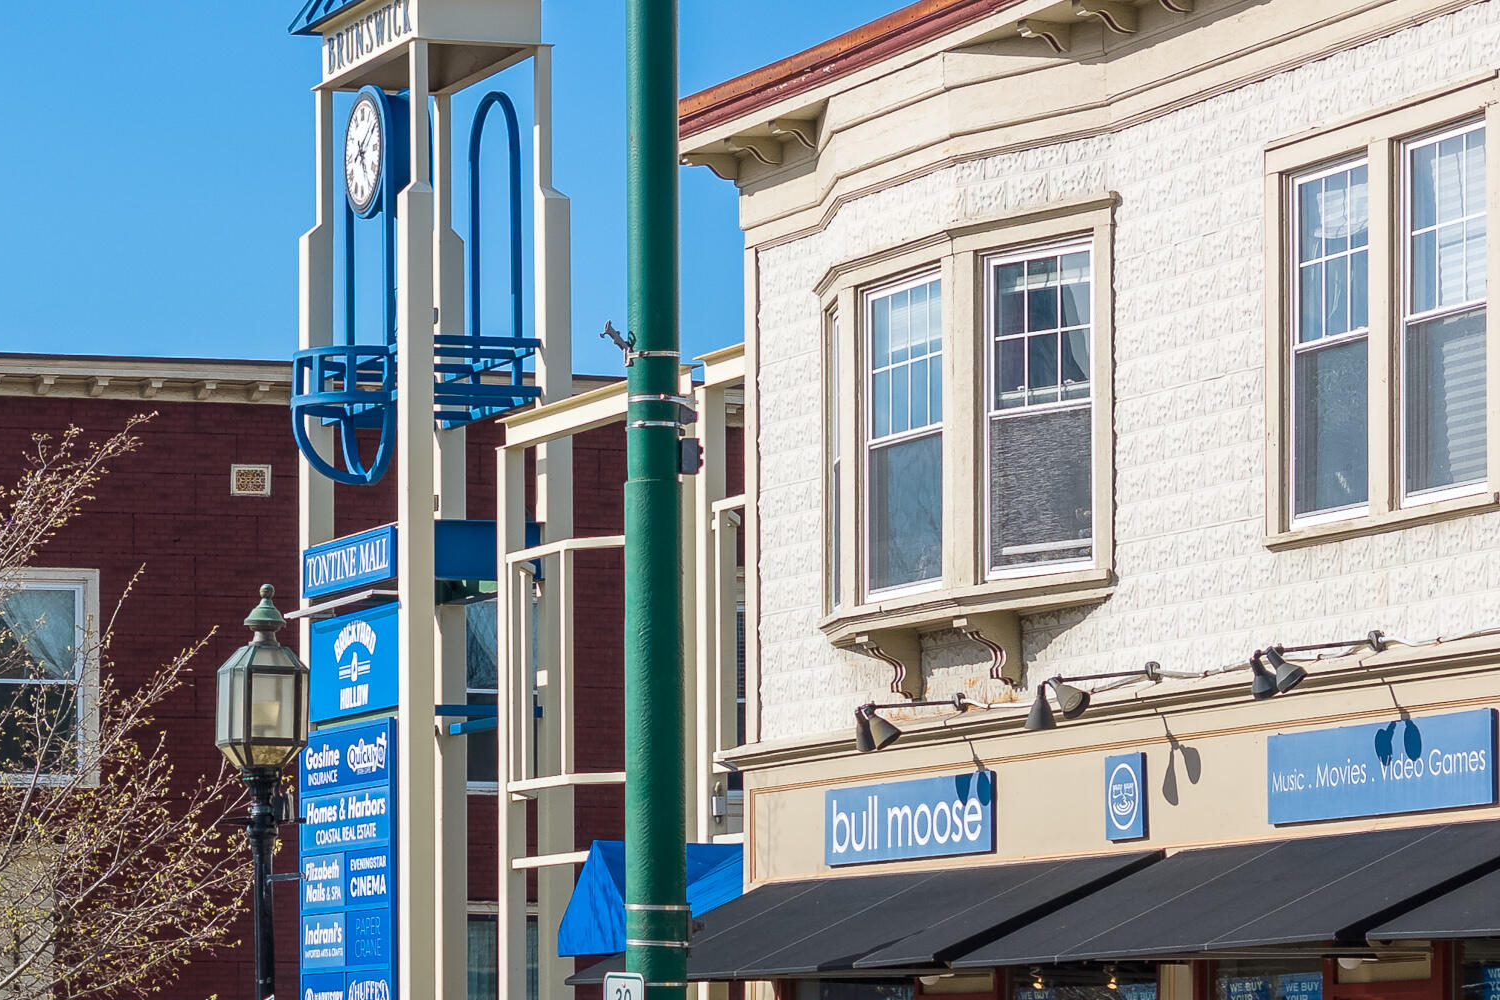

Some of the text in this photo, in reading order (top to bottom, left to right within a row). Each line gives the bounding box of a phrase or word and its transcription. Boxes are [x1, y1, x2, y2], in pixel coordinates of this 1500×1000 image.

[327, 0, 412, 75] BRUNSWICK
[306, 538, 389, 588] TONTINE MALL
[333, 619, 377, 664] BRICKYARD
[339, 683, 369, 711] HOLLOW
[305, 743, 340, 771] Gosline
[307, 768, 338, 787] INSURANCE
[1271, 768, 1305, 794] Music
[1315, 758, 1368, 789] Movies
[1379, 753, 1425, 782] Video
[1428, 748, 1487, 777] Games
[305, 792, 387, 826] Homes & Harbors
[315, 822, 377, 846] COASTAL REAL ESTATE
[832, 795, 983, 854] bull moose
[305, 882, 326, 903] Nails
[331, 885, 342, 901] SPA
[349, 873, 387, 898] CINEMA
[355, 916, 381, 936] PAPER
[354, 937, 382, 958] CRANE
[1230, 982, 1245, 992] WE
[1285, 981, 1320, 992] WE BUY
